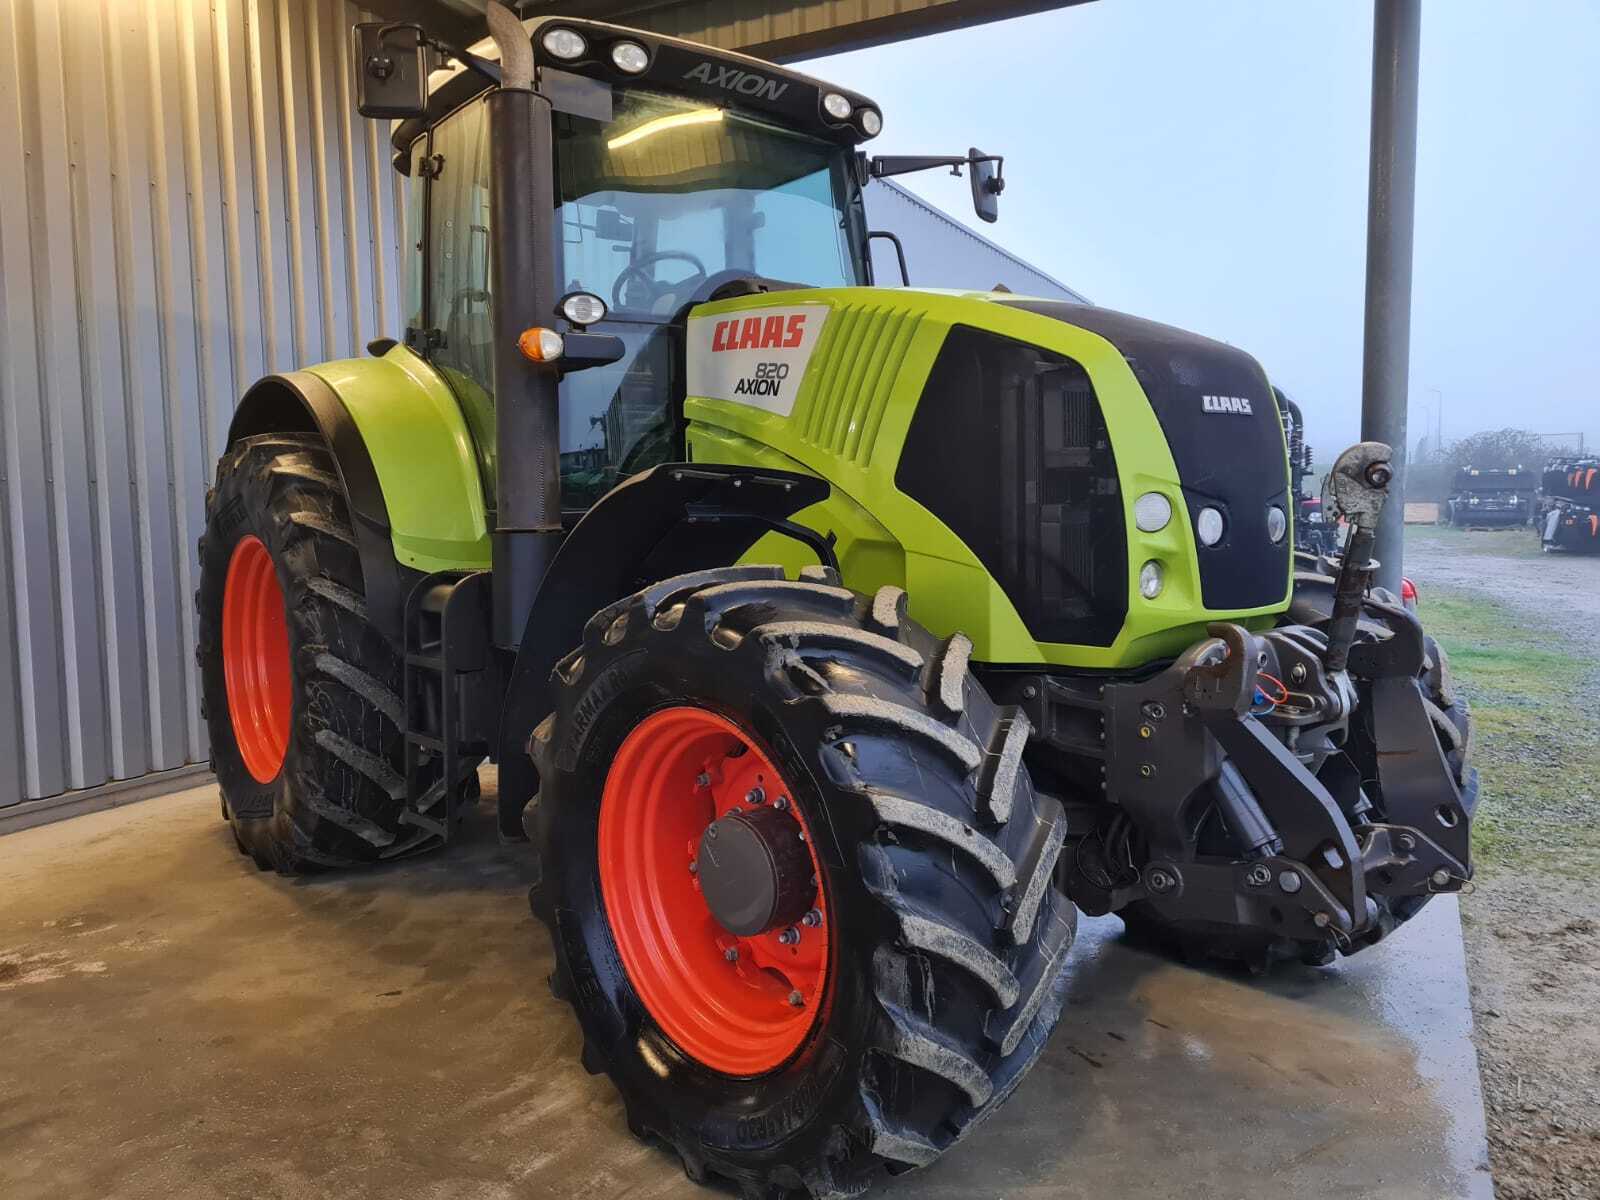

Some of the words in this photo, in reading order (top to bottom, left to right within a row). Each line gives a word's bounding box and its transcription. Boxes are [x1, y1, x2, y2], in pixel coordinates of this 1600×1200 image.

[681, 62, 789, 101] AXION
[711, 314, 807, 353] CLAAS
[755, 362, 789, 380] 820
[733, 378, 781, 397] AXION
[1202, 395, 1254, 416] CLAAS
